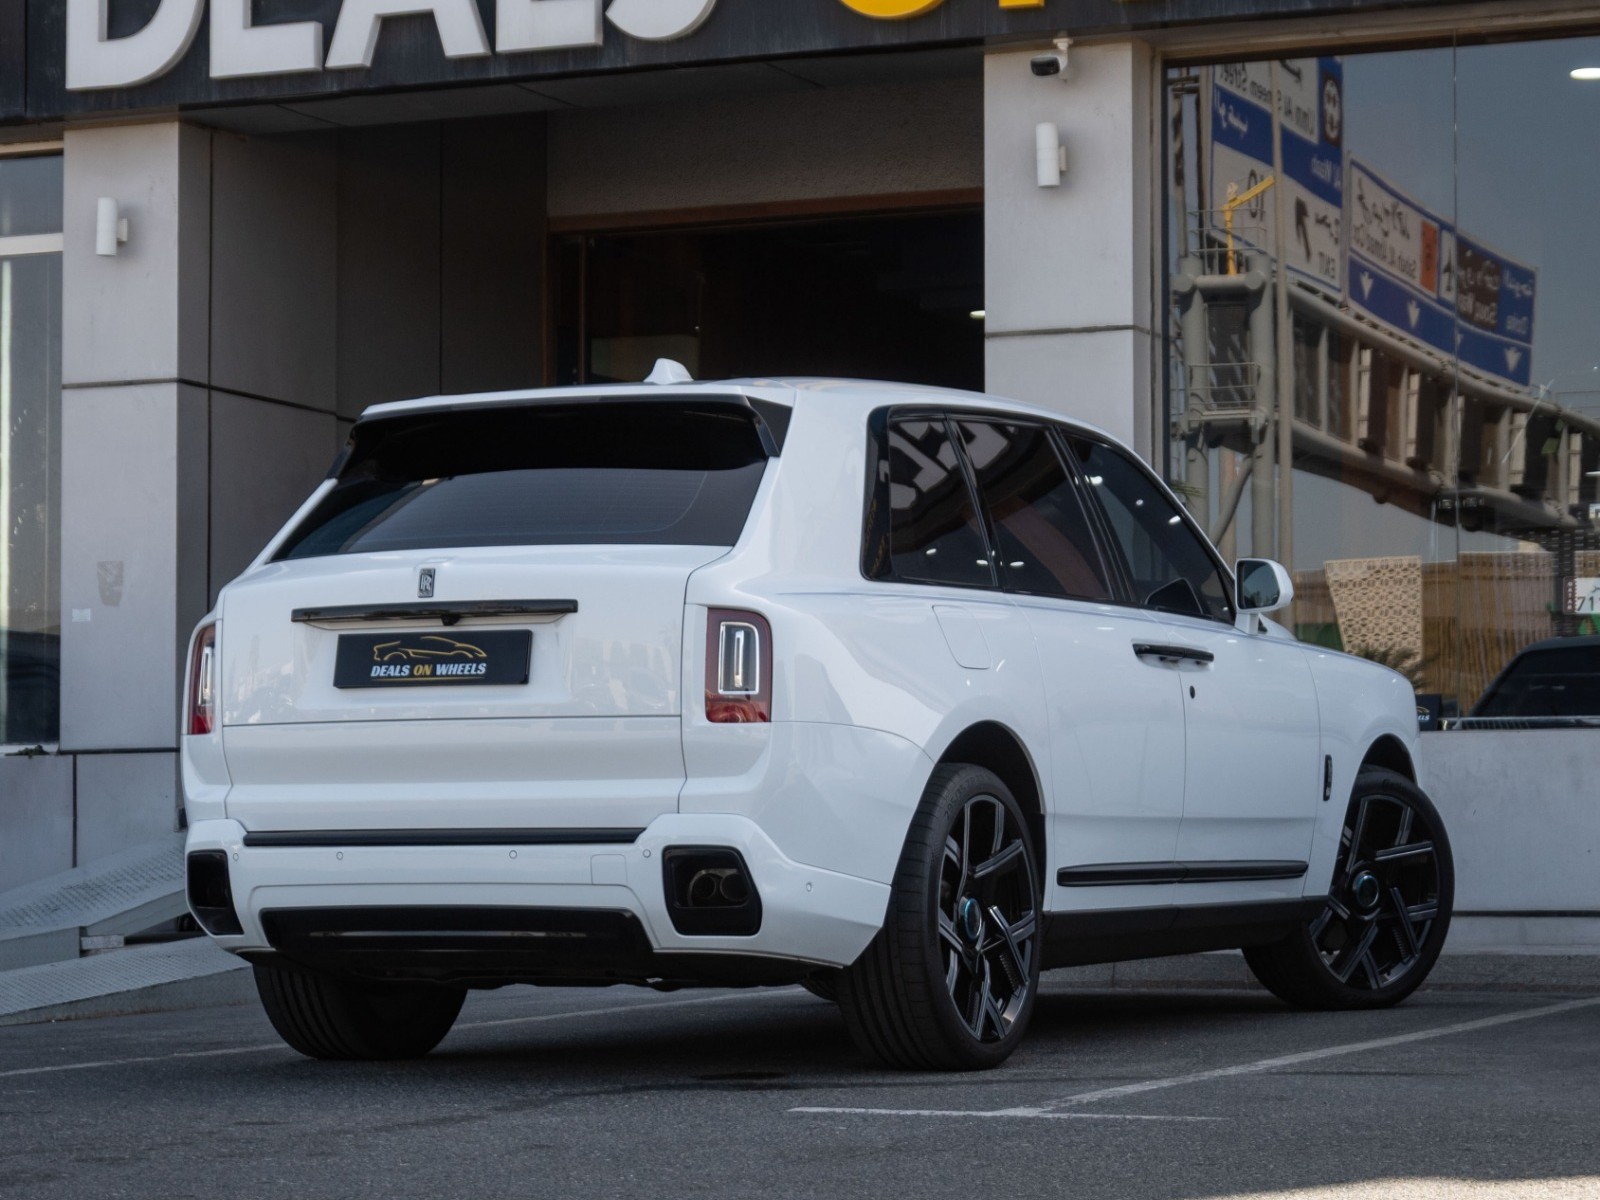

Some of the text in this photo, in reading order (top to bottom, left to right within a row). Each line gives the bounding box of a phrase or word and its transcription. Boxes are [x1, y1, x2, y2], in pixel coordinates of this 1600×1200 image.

[1577, 596, 1600, 611] 71
[370, 663, 487, 677] DEALS ON WHEELS
